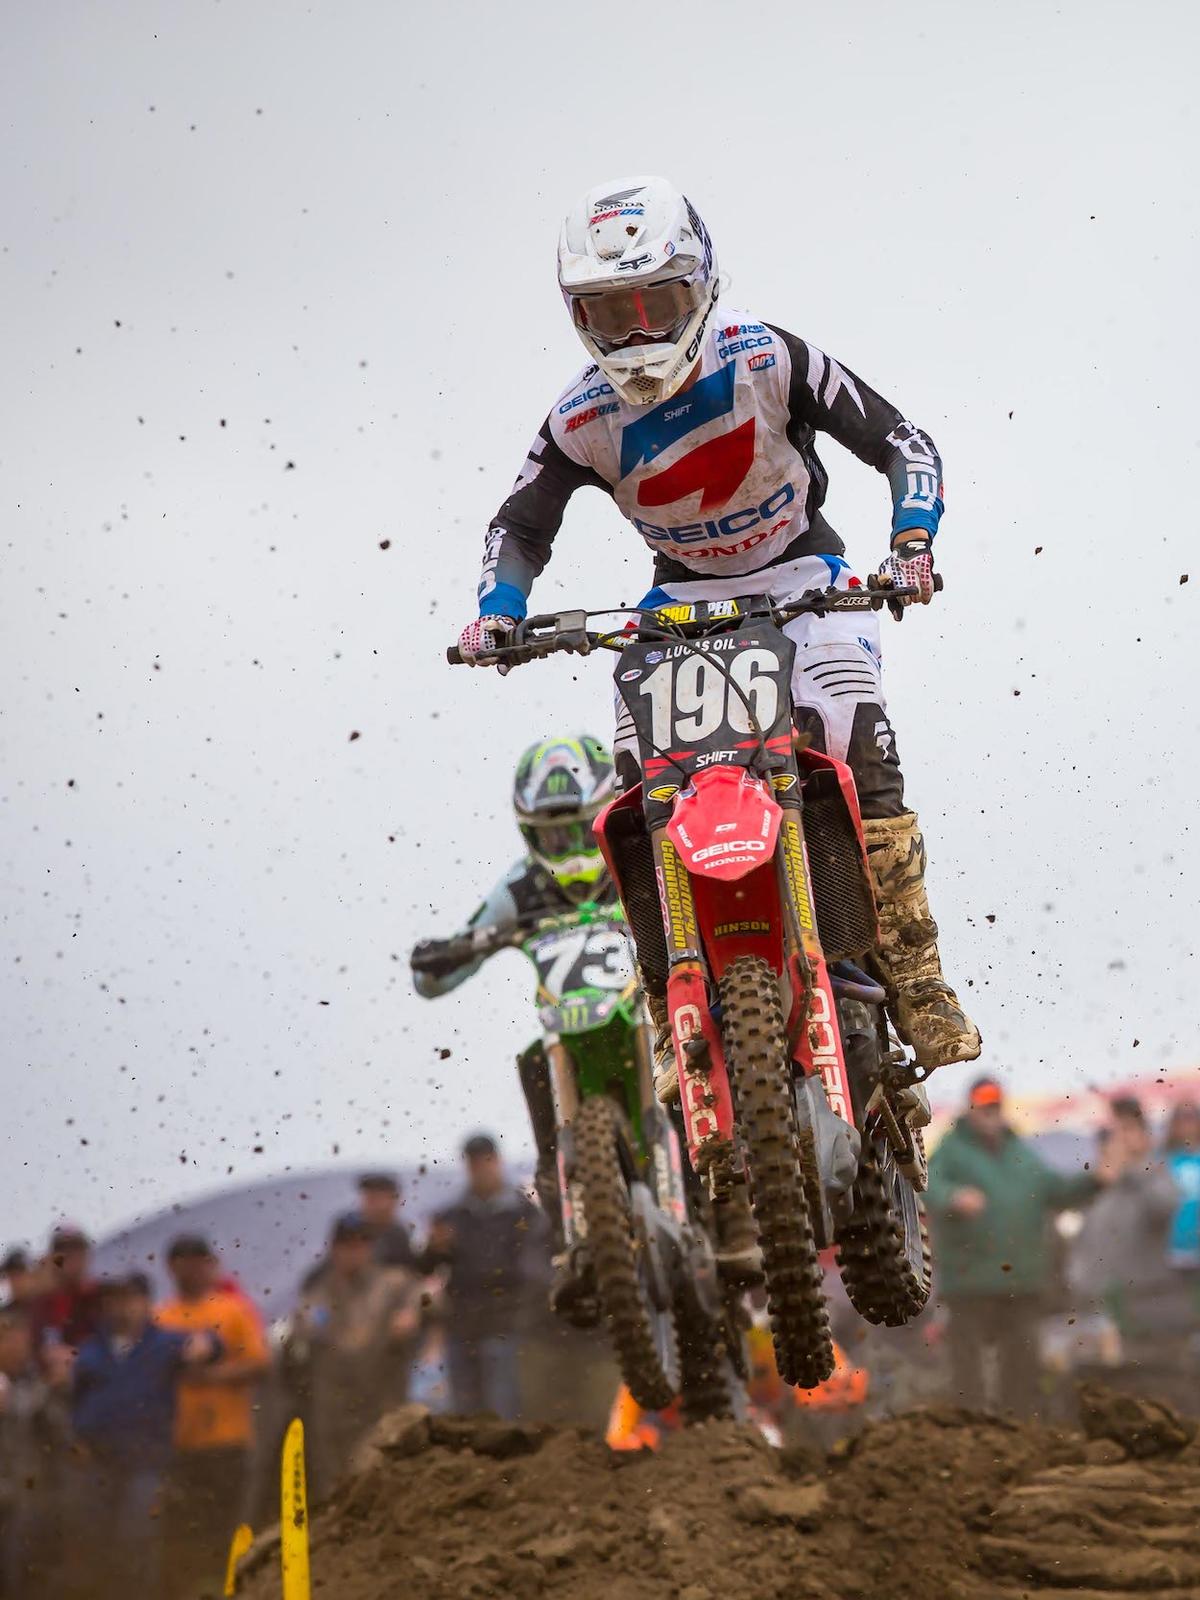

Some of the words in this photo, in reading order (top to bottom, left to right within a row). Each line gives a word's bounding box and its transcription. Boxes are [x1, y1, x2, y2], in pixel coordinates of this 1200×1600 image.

[718, 336, 773, 359] GEICO
[559, 383, 615, 414] GEICO
[563, 401, 620, 434] AMSOIL
[664, 404, 693, 421] SHIFT
[633, 482, 795, 544] GEICO
[834, 596, 872, 607] ARC
[713, 638, 737, 652] OIL
[639, 648, 780, 758] 196
[696, 751, 738, 768] SHIFT
[691, 840, 766, 863] GEICO
[704, 855, 758, 870] HONDA
[714, 921, 771, 938] HINSON
[536, 928, 637, 1001] 73
